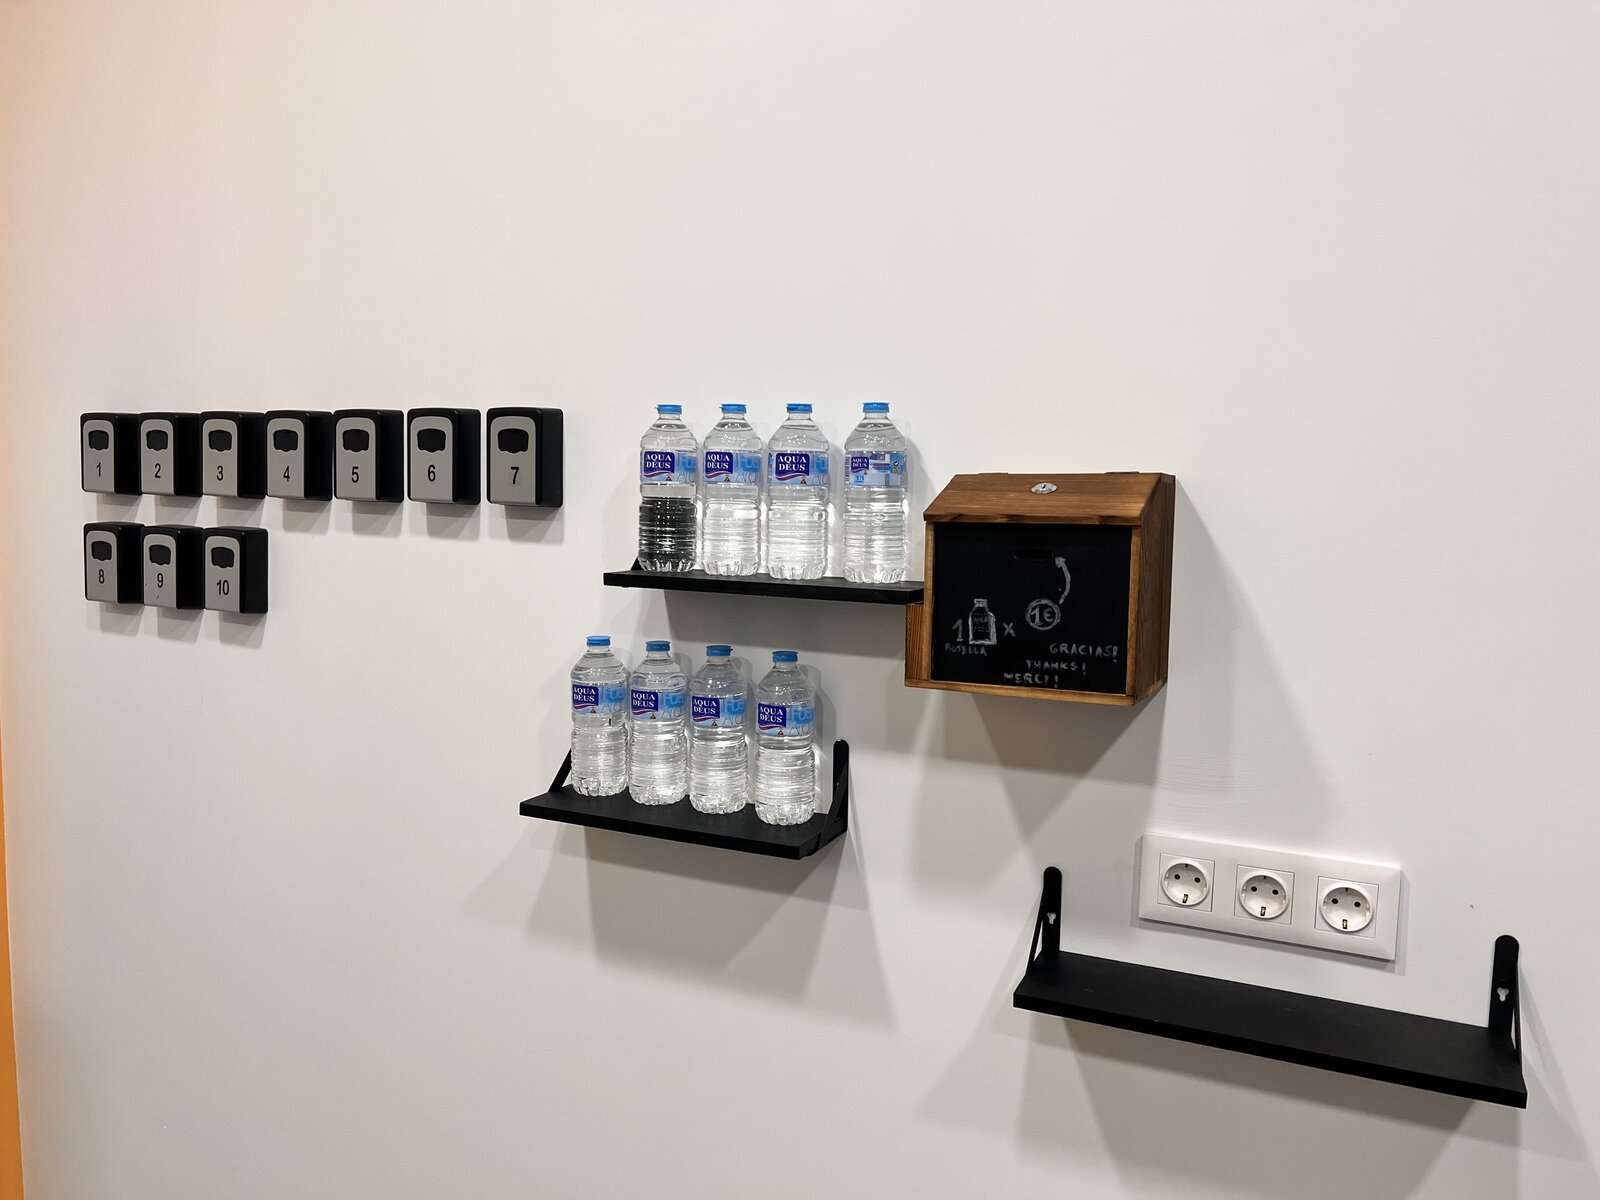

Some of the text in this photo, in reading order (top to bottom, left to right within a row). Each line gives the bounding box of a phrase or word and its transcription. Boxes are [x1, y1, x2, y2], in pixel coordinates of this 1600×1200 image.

[645, 454, 672, 462] AQUA
[707, 454, 730, 462] AQUA
[777, 455, 807, 464] AQUA
[96, 462, 102, 477] 1
[646, 461, 671, 469] DEUS
[778, 463, 806, 471] DEUS
[154, 463, 161, 479] 2
[216, 465, 224, 481] 3
[282, 465, 291, 482] 4
[351, 466, 360, 483] 5
[427, 464, 436, 482] 6
[510, 466, 520, 485] 7
[98, 569, 105, 584] 8
[157, 573, 164, 588] 9
[216, 580, 230, 596] 10
[952, 618, 964, 642] 1
[573, 687, 596, 695] AQUA
[632, 692, 656, 700] AQUA
[573, 694, 595, 702] DEUS
[693, 699, 717, 707] AQUA
[693, 706, 716, 714] DEUS
[760, 706, 783, 715] AQUA
[760, 713, 783, 723] DEUS
